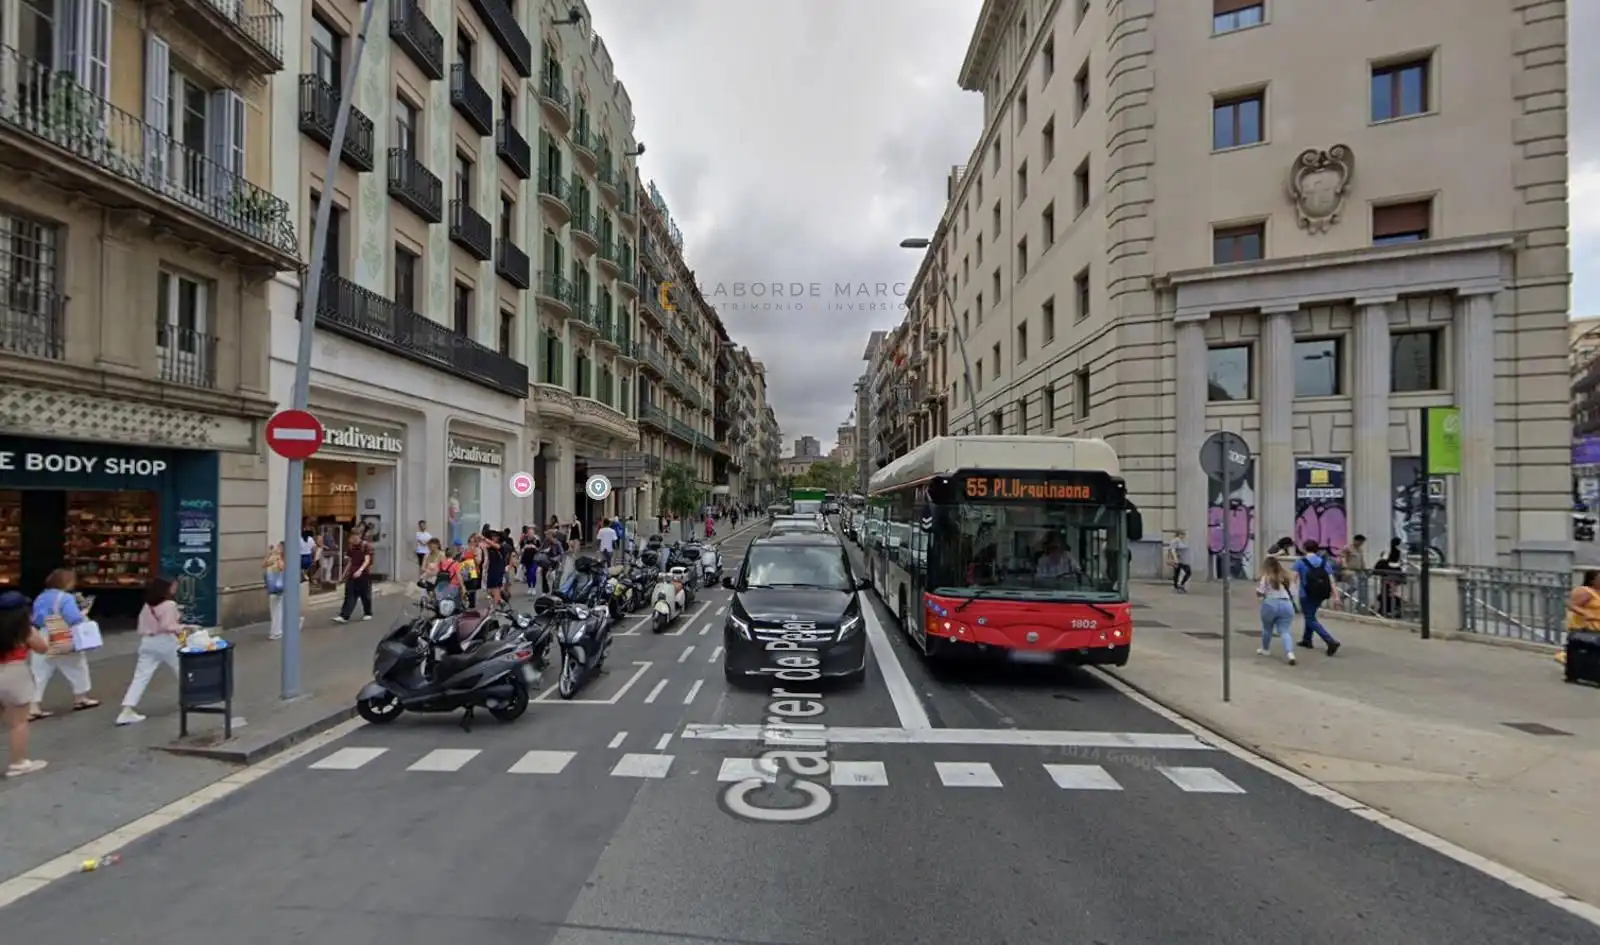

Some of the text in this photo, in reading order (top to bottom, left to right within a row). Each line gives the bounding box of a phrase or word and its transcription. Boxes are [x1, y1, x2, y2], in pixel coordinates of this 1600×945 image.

[25, 452, 98, 473] BODY
[104, 458, 168, 476] SHOP
[966, 477, 988, 497] 55
